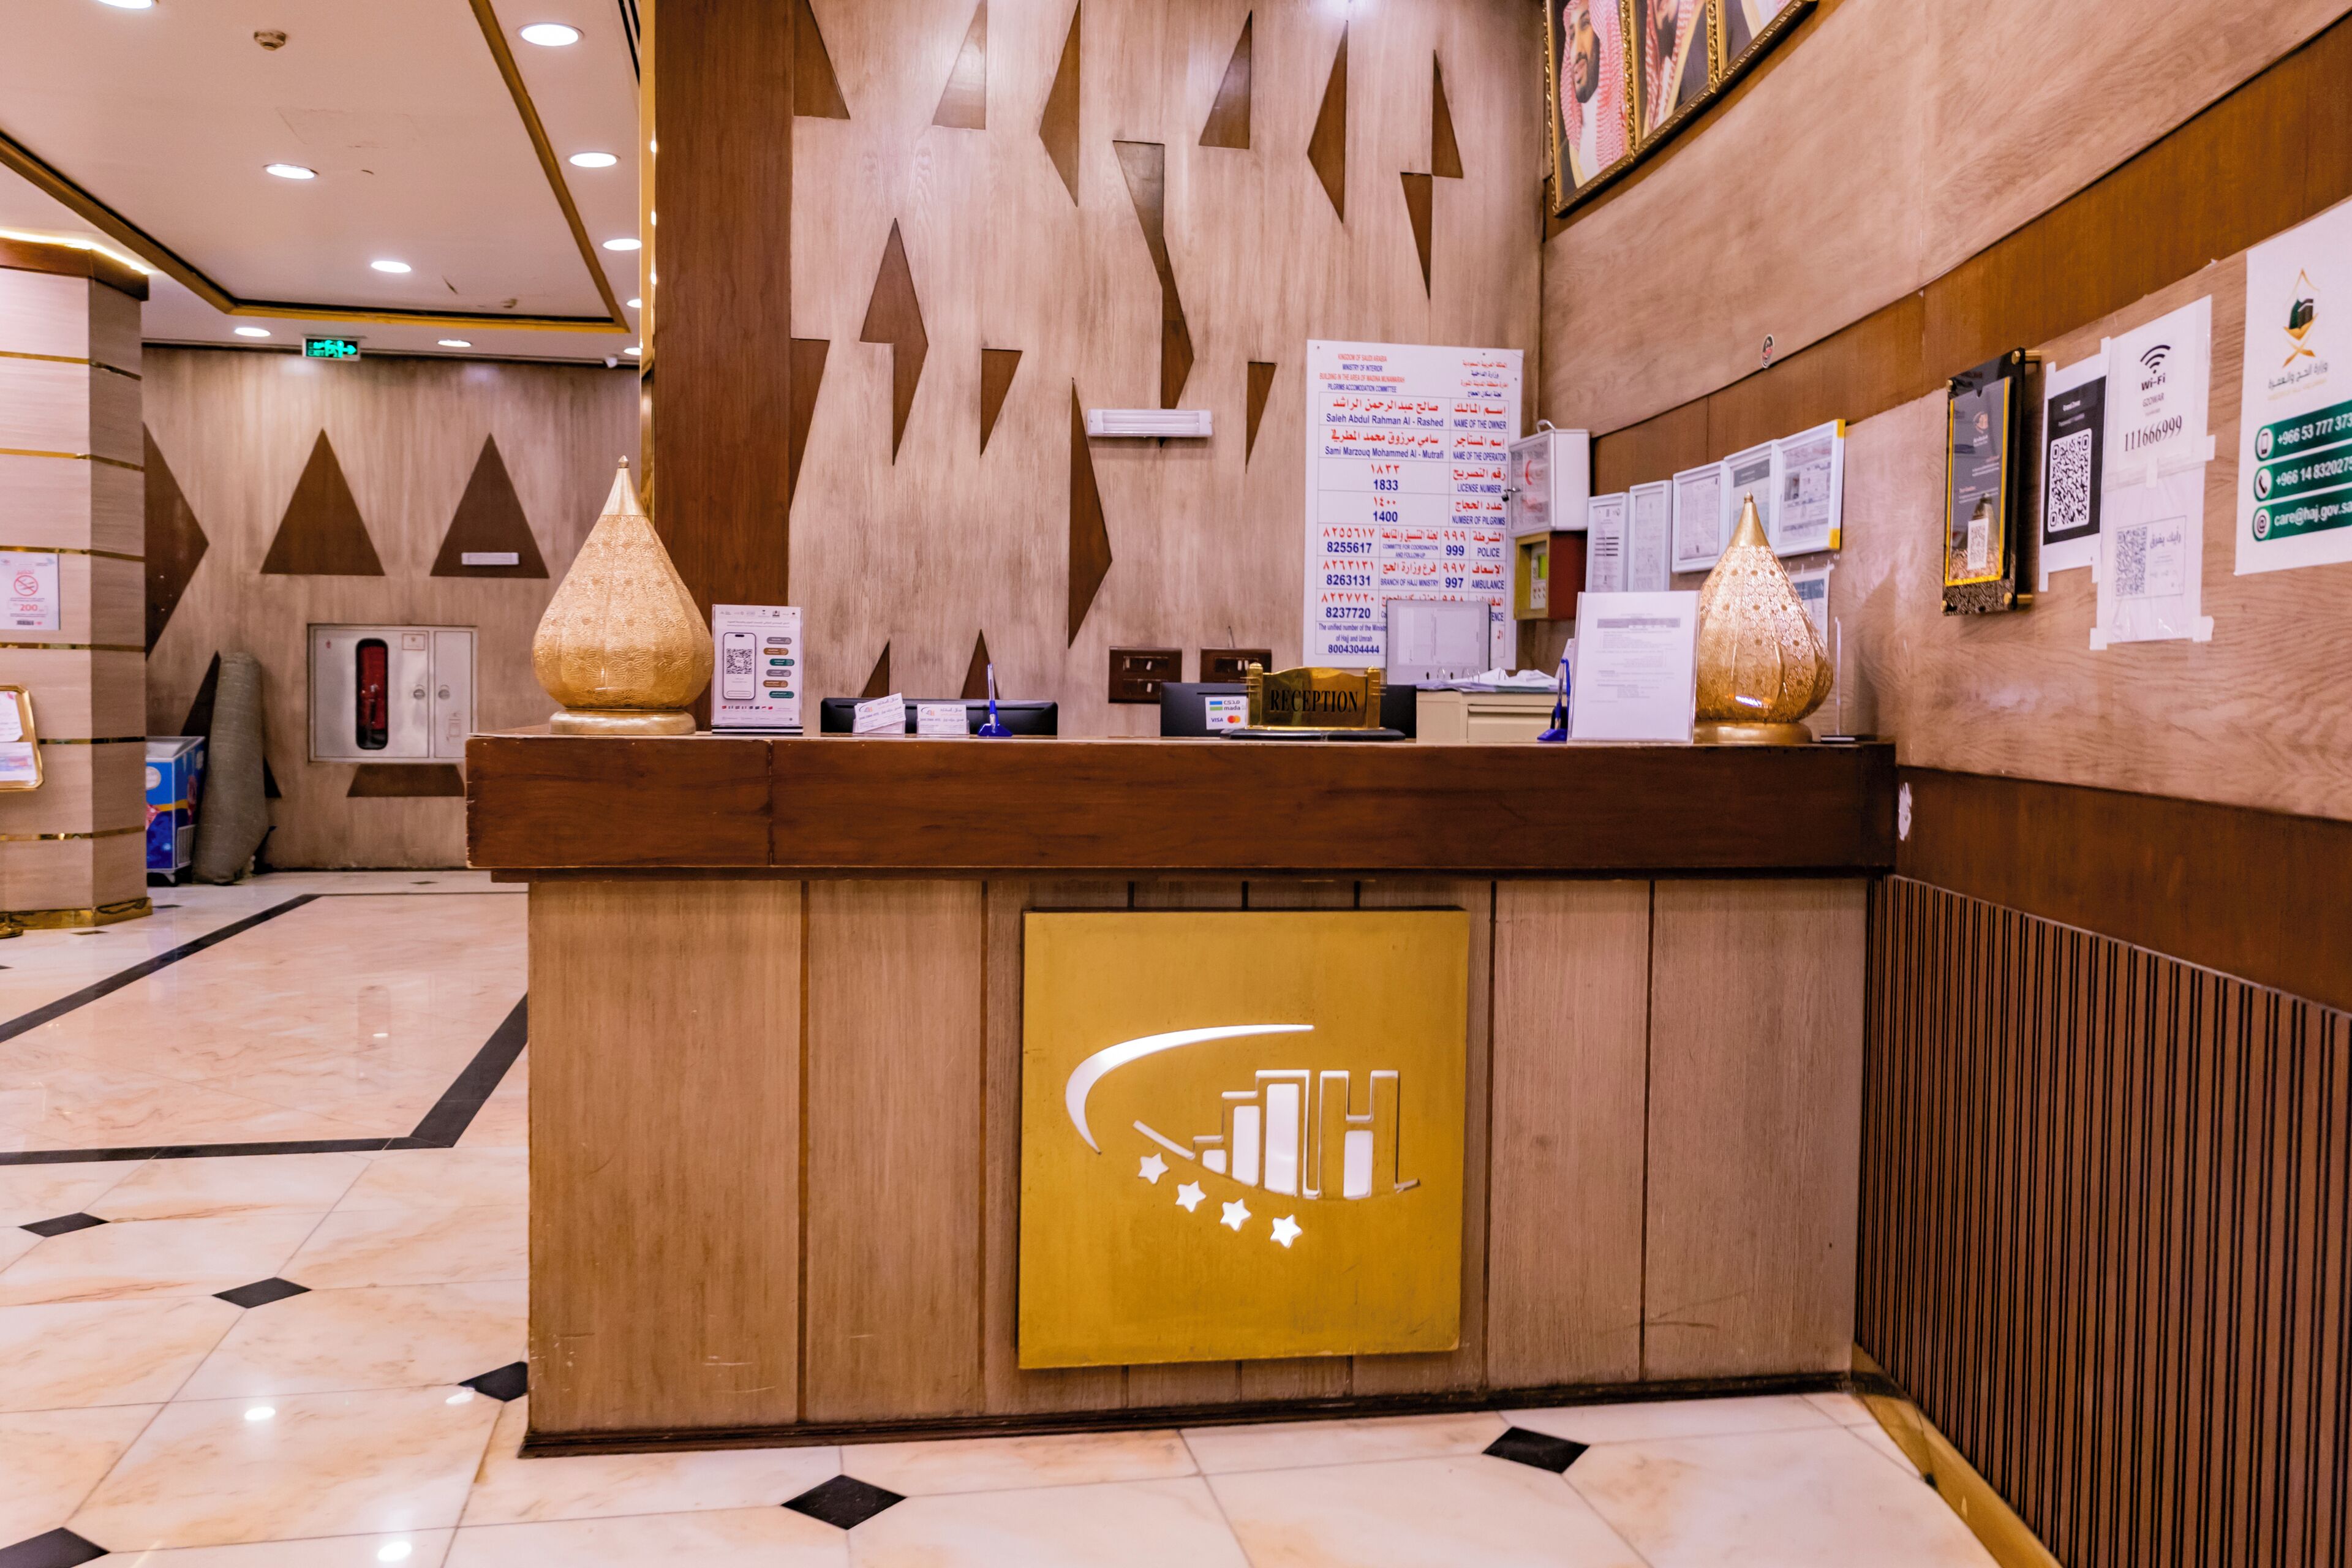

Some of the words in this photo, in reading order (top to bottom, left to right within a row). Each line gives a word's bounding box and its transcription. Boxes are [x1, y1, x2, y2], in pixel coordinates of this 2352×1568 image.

[2141, 372, 2166, 391] Wi-Fi
[1333, 396, 1362, 411] الراشد
[1416, 402, 1439, 414] صالح
[1454, 403, 1480, 414] المالك
[1326, 413, 1346, 423] Saleh
[1349, 414, 1370, 424] Abdul
[1372, 415, 1401, 425] Rahman
[1403, 417, 1411, 425] Al
[1417, 417, 1444, 427] Rashed
[1477, 420, 1487, 429] THE
[1488, 420, 1506, 429] OWNER
[1363, 432, 1385, 442] محمد
[2125, 415, 2182, 451] 111666999
[2277, 428, 2300, 445] +966
[2301, 424, 2313, 440] 53
[2315, 418, 2334, 436] 777
[1387, 432, 1415, 445] مرزوق
[1417, 434, 1439, 447] سامي
[1325, 446, 1341, 455] Sami
[1343, 447, 1370, 458] Marzouq
[1372, 448, 1408, 458] Mohammed
[1422, 450, 1444, 459] Mutrafi
[1453, 451, 1465, 459] NAME
[1466, 451, 1472, 460] OF
[1483, 452, 1506, 461] OPERATOR
[1453, 467, 1488, 481] التصريح
[1491, 467, 1506, 481] رقم
[2275, 472, 2298, 486] +966
[2301, 466, 2312, 481] 14
[1373, 479, 1398, 491] 1833
[1457, 483, 1479, 492] LICENSE
[1480, 484, 1501, 494] NUMBER
[1455, 500, 1482, 513] الحجاج
[1373, 511, 1398, 522] 1400
[1452, 515, 1473, 525] NUMBER
[1474, 516, 1481, 525] OF
[1482, 516, 1506, 526] PILGRIMS
[1444, 530, 1466, 541] ٩٩٩
[1472, 530, 1504, 545] الشرطة
[1327, 541, 1372, 553] 8255617
[1446, 545, 1464, 556] 999
[1477, 547, 1500, 557] POLICE
[1382, 562, 1399, 575] الحج
[1401, 561, 1421, 575] وزارة
[1423, 562, 1436, 576] فرع
[1443, 562, 1465, 573] ٩٩٧
[1326, 574, 1370, 586] 8263131
[1446, 577, 1464, 589] 997
[1471, 579, 1504, 590] AMBULANCE
[1326, 607, 1371, 619] 8237720
[1328, 644, 1379, 654] 8004304444
[1270, 690, 1358, 713] RECEPTION
